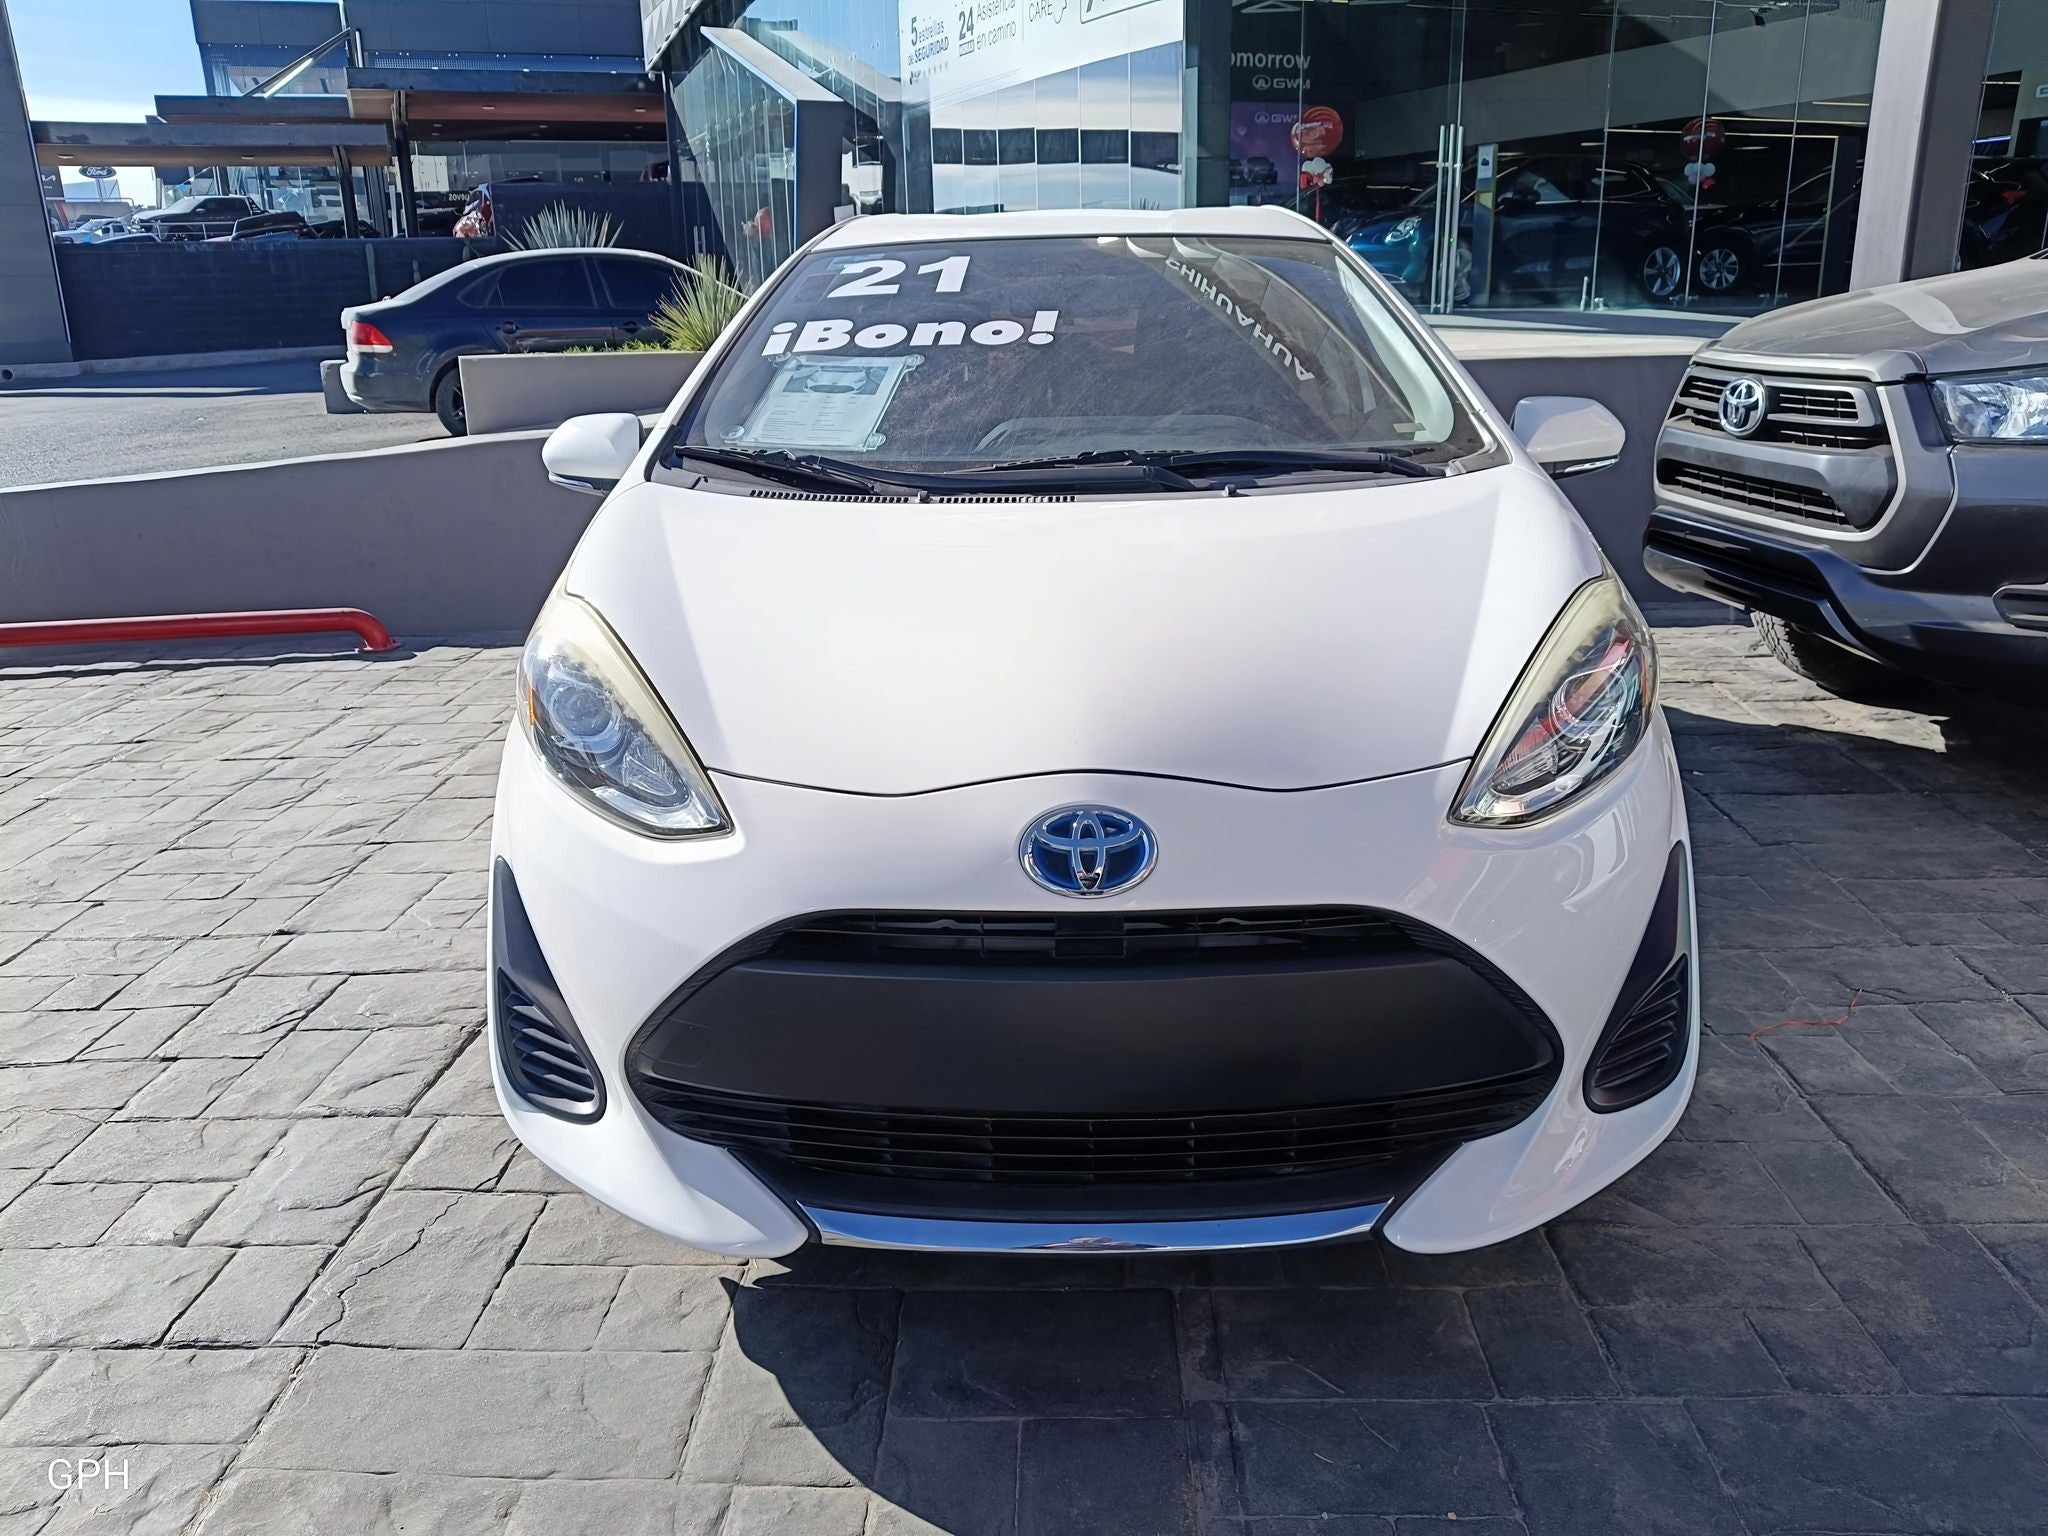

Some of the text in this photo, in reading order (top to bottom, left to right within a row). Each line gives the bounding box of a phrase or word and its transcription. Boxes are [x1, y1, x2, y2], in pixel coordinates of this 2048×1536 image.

[911, 16, 918, 46] 5
[959, 6, 974, 40] 24
[988, 20, 1017, 45] camino
[914, 36, 949, 63] SEGURIDAD
[86, 166, 109, 176] Ford
[827, 256, 970, 298] 21
[762, 310, 1059, 356] ¡Bono!
